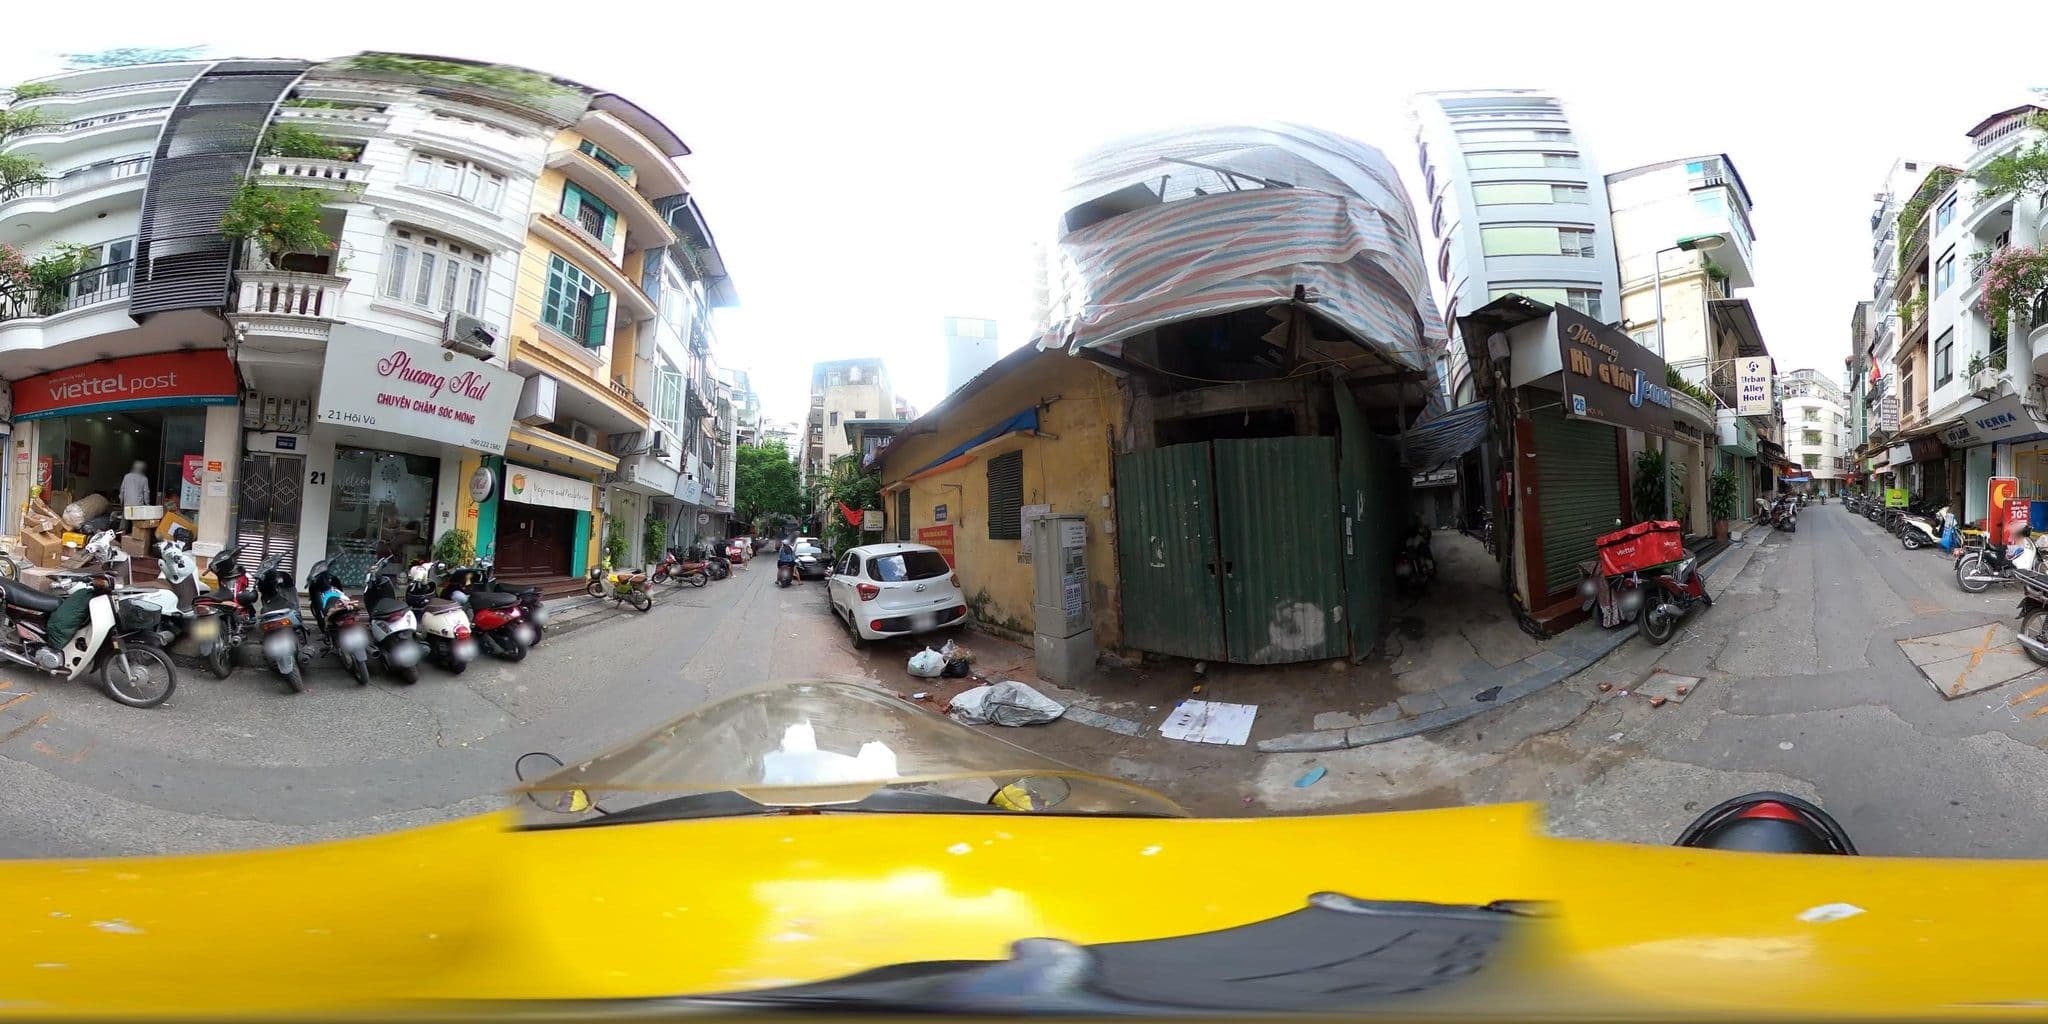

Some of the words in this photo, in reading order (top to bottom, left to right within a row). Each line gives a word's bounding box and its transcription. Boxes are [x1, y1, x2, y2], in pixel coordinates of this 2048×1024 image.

[50, 374, 128, 401] viettel
[130, 372, 177, 394] post
[449, 371, 491, 401] Nail
[1743, 384, 1764, 393] Alley
[1743, 393, 1765, 402] Hotel
[327, 410, 341, 420] 21
[1976, 412, 2017, 429] VERRA
[310, 471, 326, 485] 21
